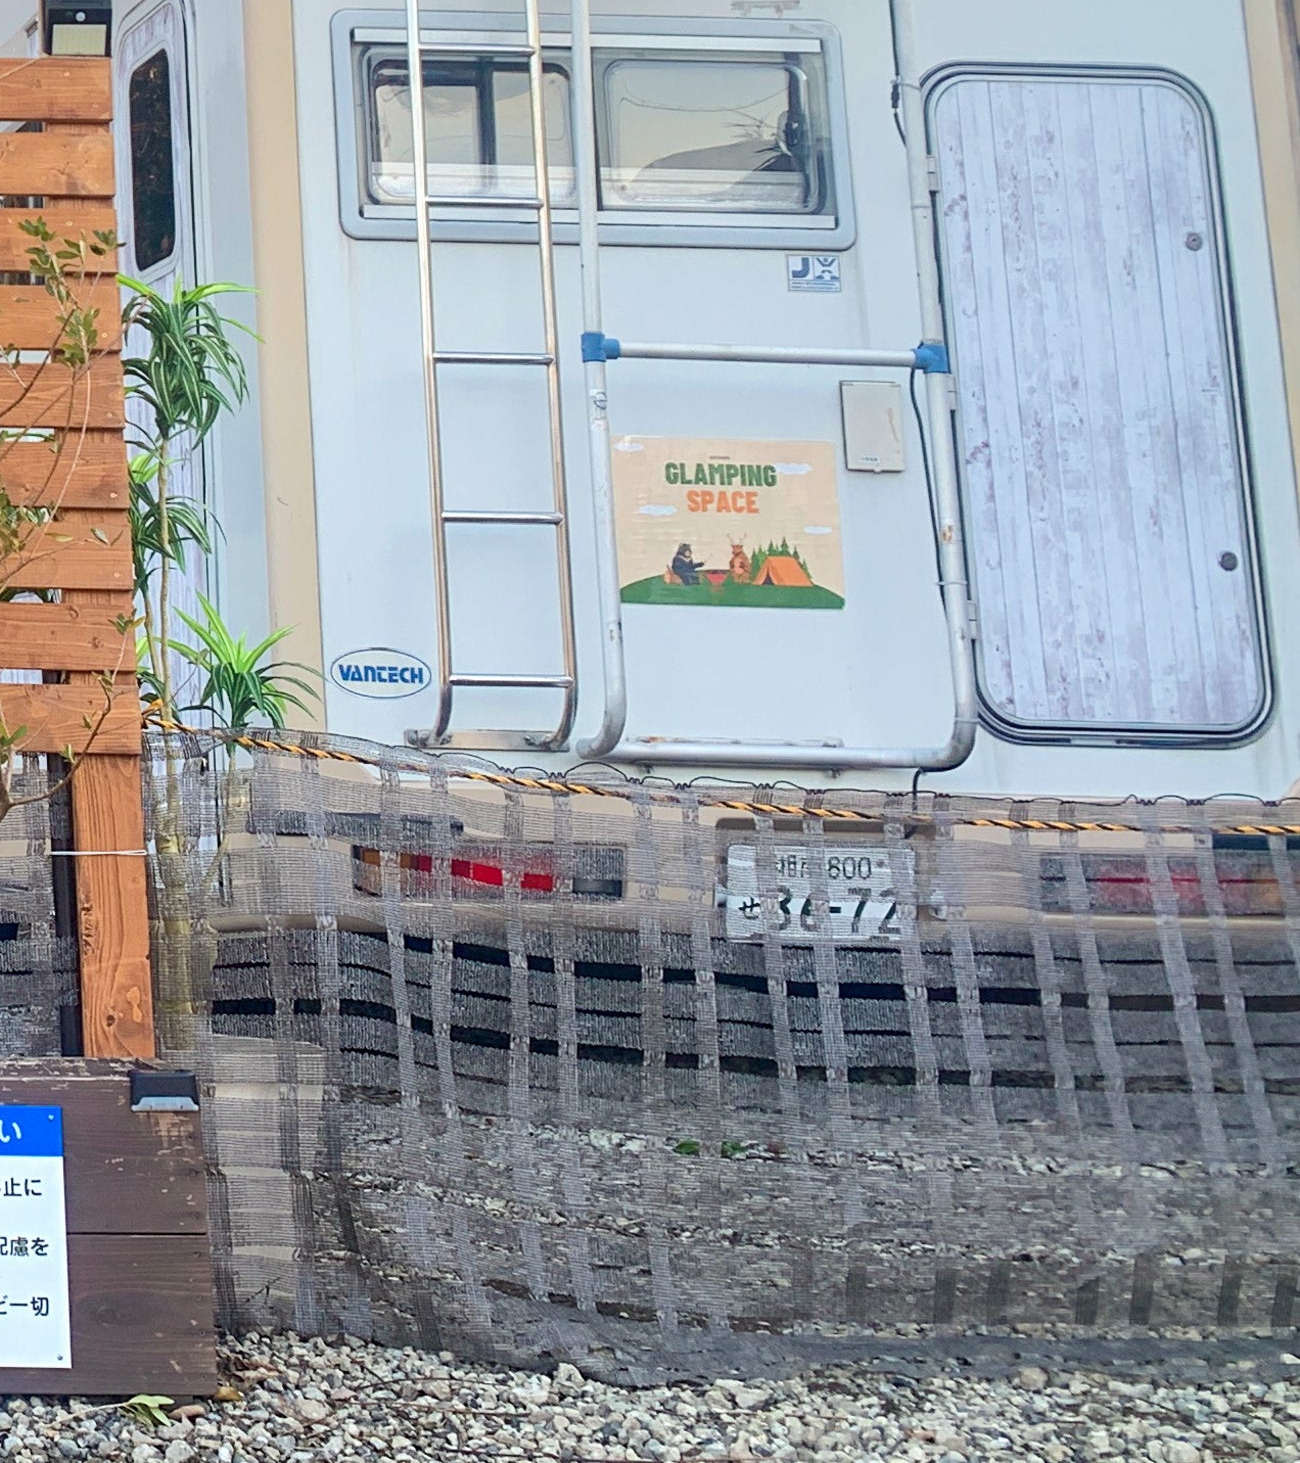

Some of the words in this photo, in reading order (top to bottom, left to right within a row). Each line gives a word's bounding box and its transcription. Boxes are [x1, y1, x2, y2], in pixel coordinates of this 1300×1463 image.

[665, 462, 777, 487] GLAMPING
[686, 490, 759, 514] SPACE
[338, 665, 424, 684] VANTECH
[827, 856, 872, 880] 800
